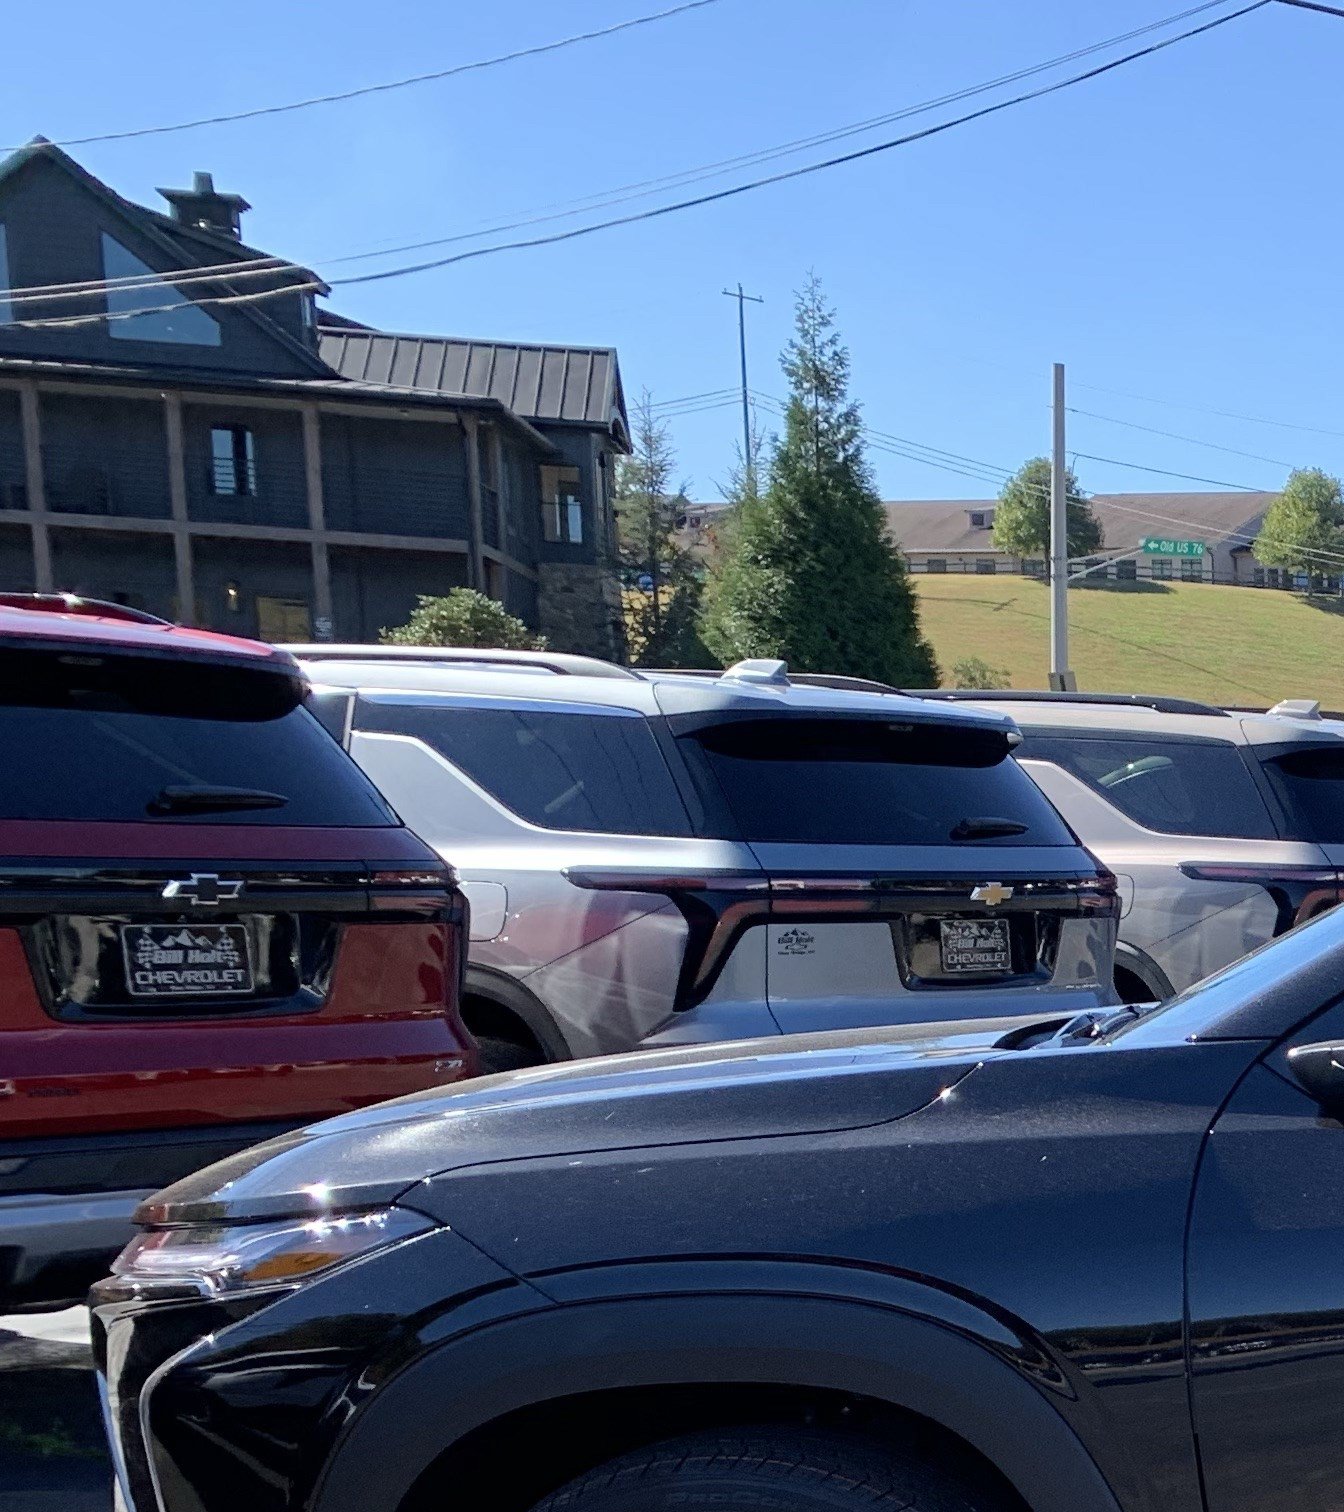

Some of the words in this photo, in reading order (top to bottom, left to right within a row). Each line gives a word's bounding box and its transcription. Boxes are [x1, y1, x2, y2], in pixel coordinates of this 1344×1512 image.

[1160, 541, 1174, 552] Old
[1177, 542, 1188, 553] US
[1193, 543, 1203, 554] 76
[947, 953, 1006, 963] CHEVROLET
[135, 969, 246, 984] CHEVROLET
